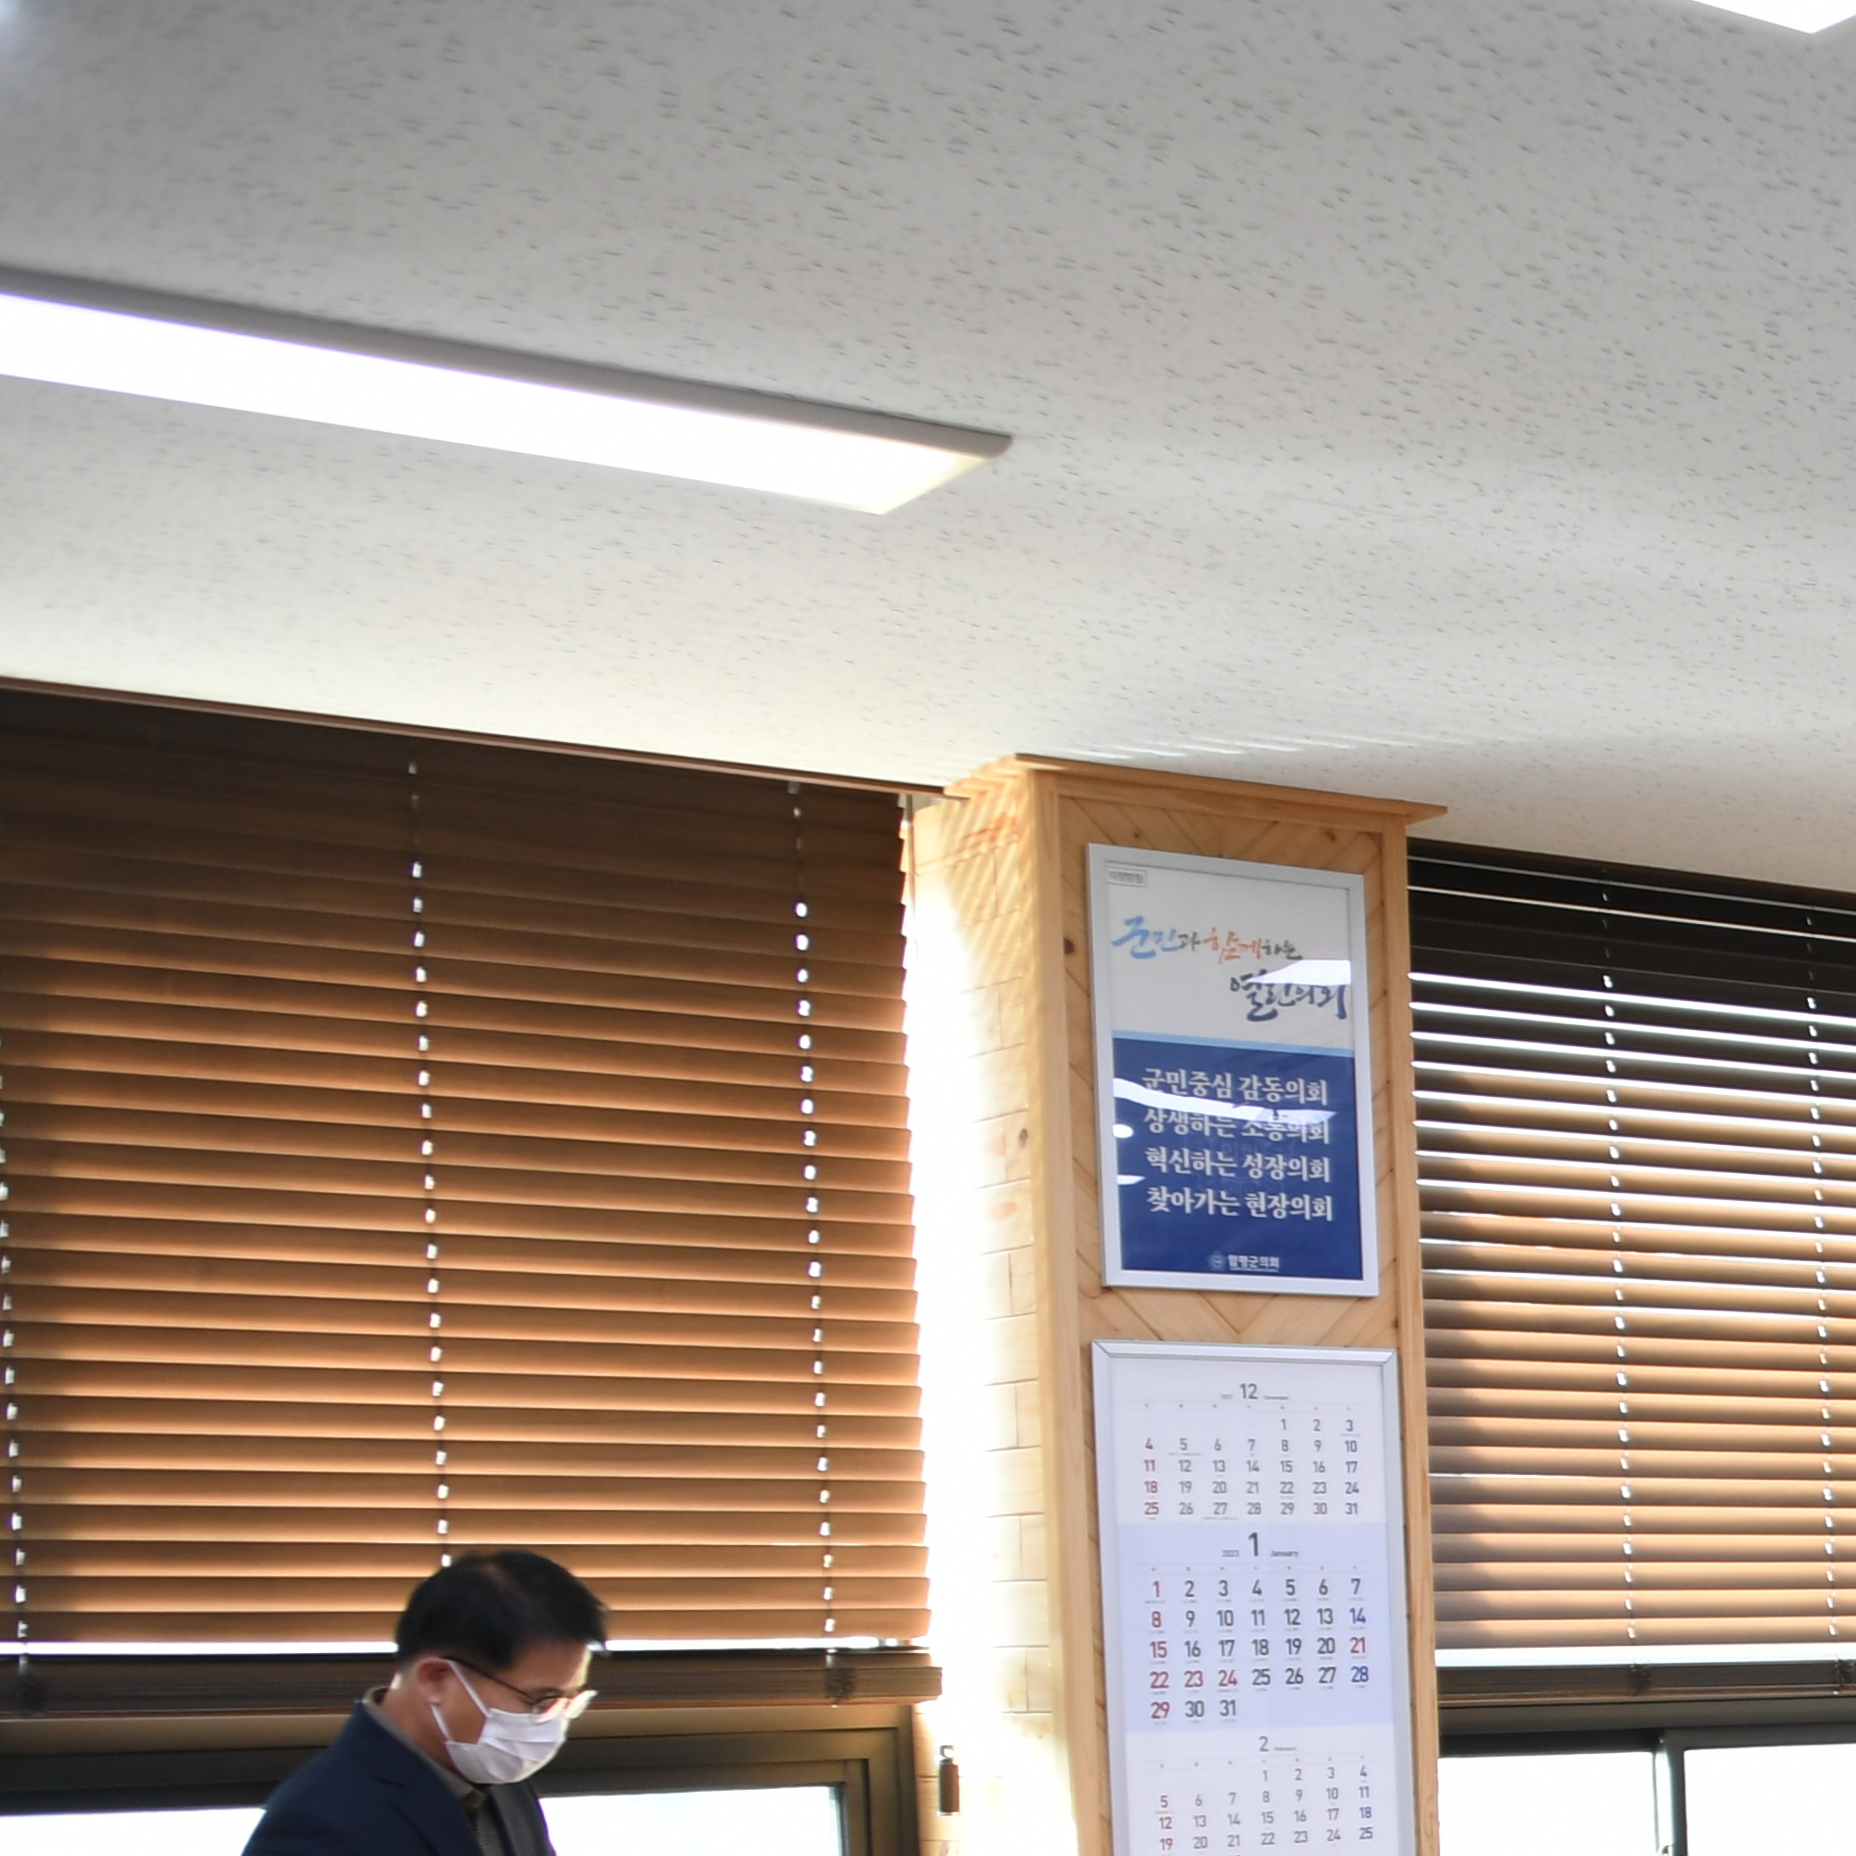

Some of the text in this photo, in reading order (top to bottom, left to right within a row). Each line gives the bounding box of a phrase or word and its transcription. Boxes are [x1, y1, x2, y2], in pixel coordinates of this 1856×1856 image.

[1142, 1068, 1328, 1106] 군민중심 감동의회
[1143, 1107, 1237, 1138] 상생하는
[1145, 1146, 1331, 1183] 혁신하는 성장의회
[1147, 1185, 1333, 1222] 찾아가는 현장의회
[1240, 1383, 1258, 1399] 12
[1280, 1418, 1354, 1432] 1 2 3
[1144, 1438, 1357, 1452] 4 5 6 7 8 9 10
[1144, 1459, 1357, 1473] 11 12 13 14 15 16 17
[1145, 1481, 1359, 1494] 18 19 20 21 22 23 24
[1145, 1502, 1358, 1515] 25 26 27 28 29 30 31
[1248, 1531, 1259, 1557] 1
[1152, 1578, 1361, 1598] 1 2 3 4 5 6 7
[1151, 1608, 1366, 1628] 8 9 10 11 12 13 14
[1150, 1637, 1365, 1658] 15 16 17 18 19 20 21
[1150, 1666, 1369, 1689] 22 23 24 25 26 27 28
[1151, 1699, 1236, 1719] 29 30 31
[1258, 1736, 1270, 1752] 2
[1262, 1766, 1368, 1783] 1 2 3 4
[1160, 1786, 1369, 1808] 5 6 7 8 9 10 11
[1160, 1806, 1372, 1829] 12 13 14 15 16 17 18
[1160, 1827, 1373, 1850] 19 20 21 22 23 24 25
